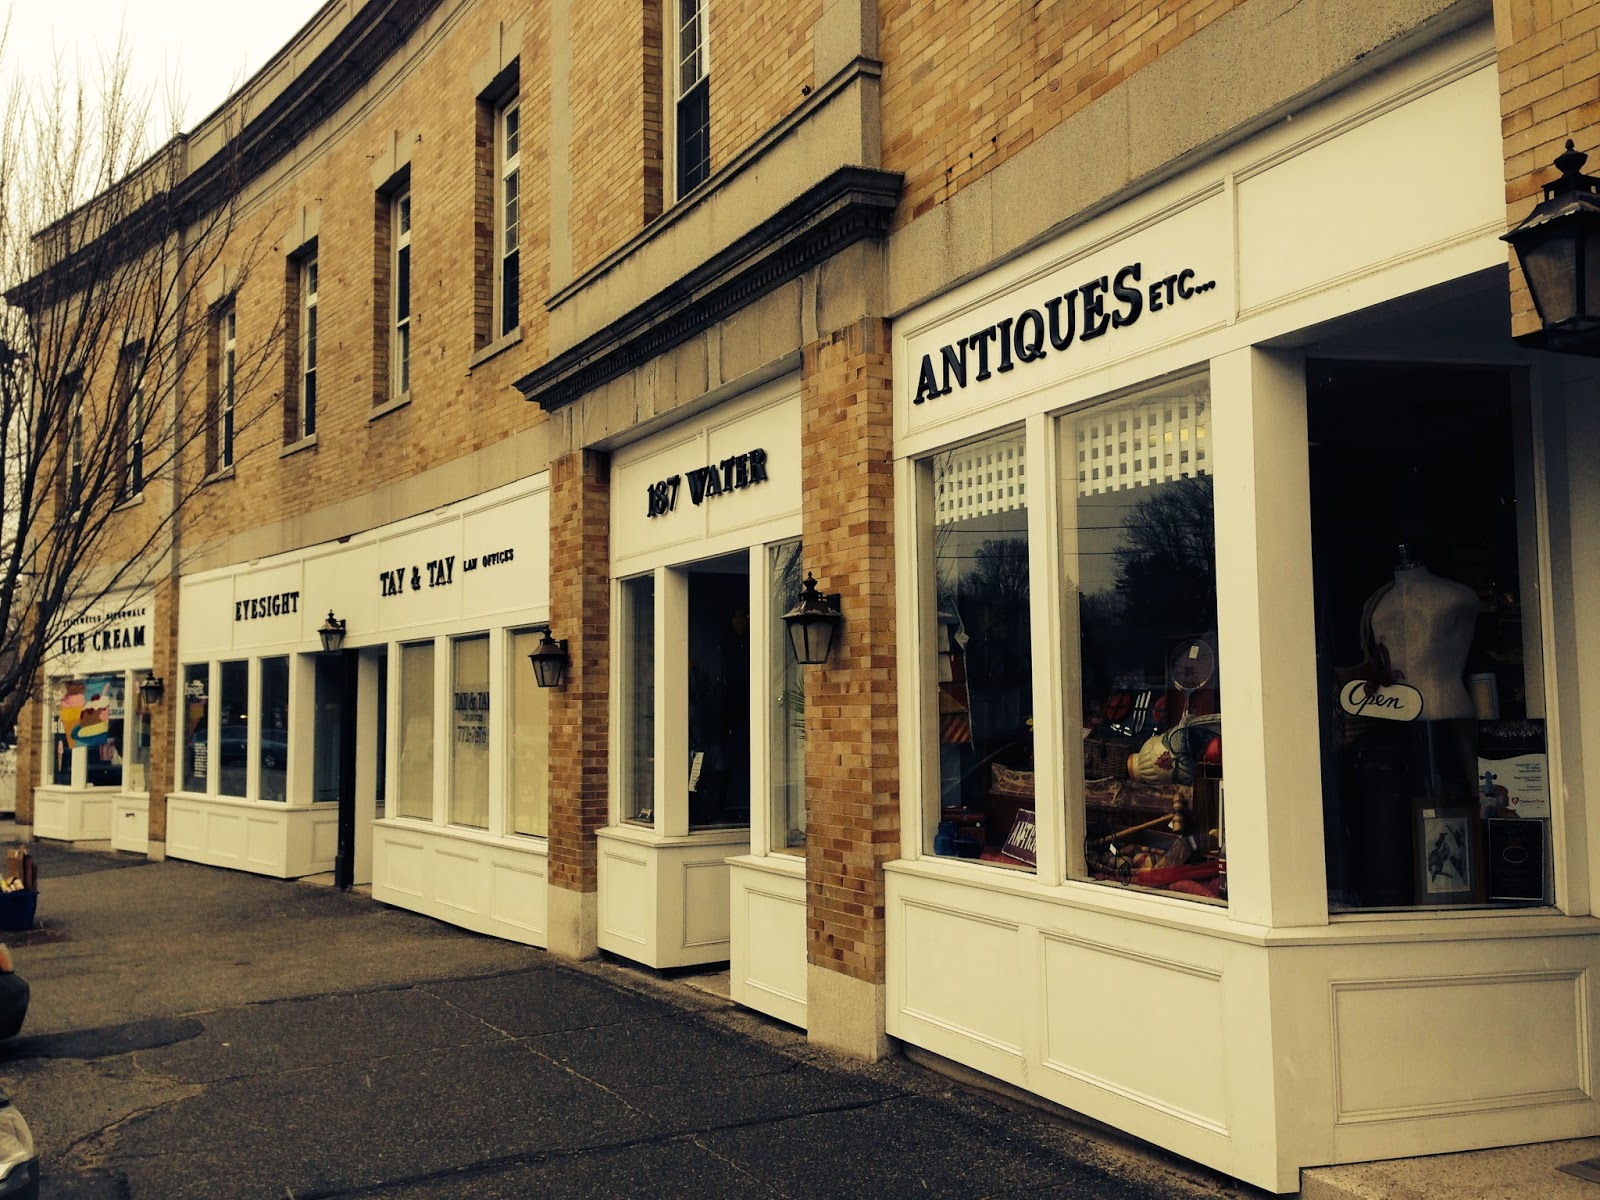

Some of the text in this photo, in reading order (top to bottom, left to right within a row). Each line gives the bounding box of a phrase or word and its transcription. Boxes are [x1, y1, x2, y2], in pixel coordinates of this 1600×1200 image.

[913, 262, 1143, 405] ANTIQUES
[646, 474, 682, 518] 187
[379, 548, 514, 597] TAY & TAY LAW OFFICES
[234, 590, 300, 622] EYESIGHT
[61, 625, 146, 655] ICE CREAM
